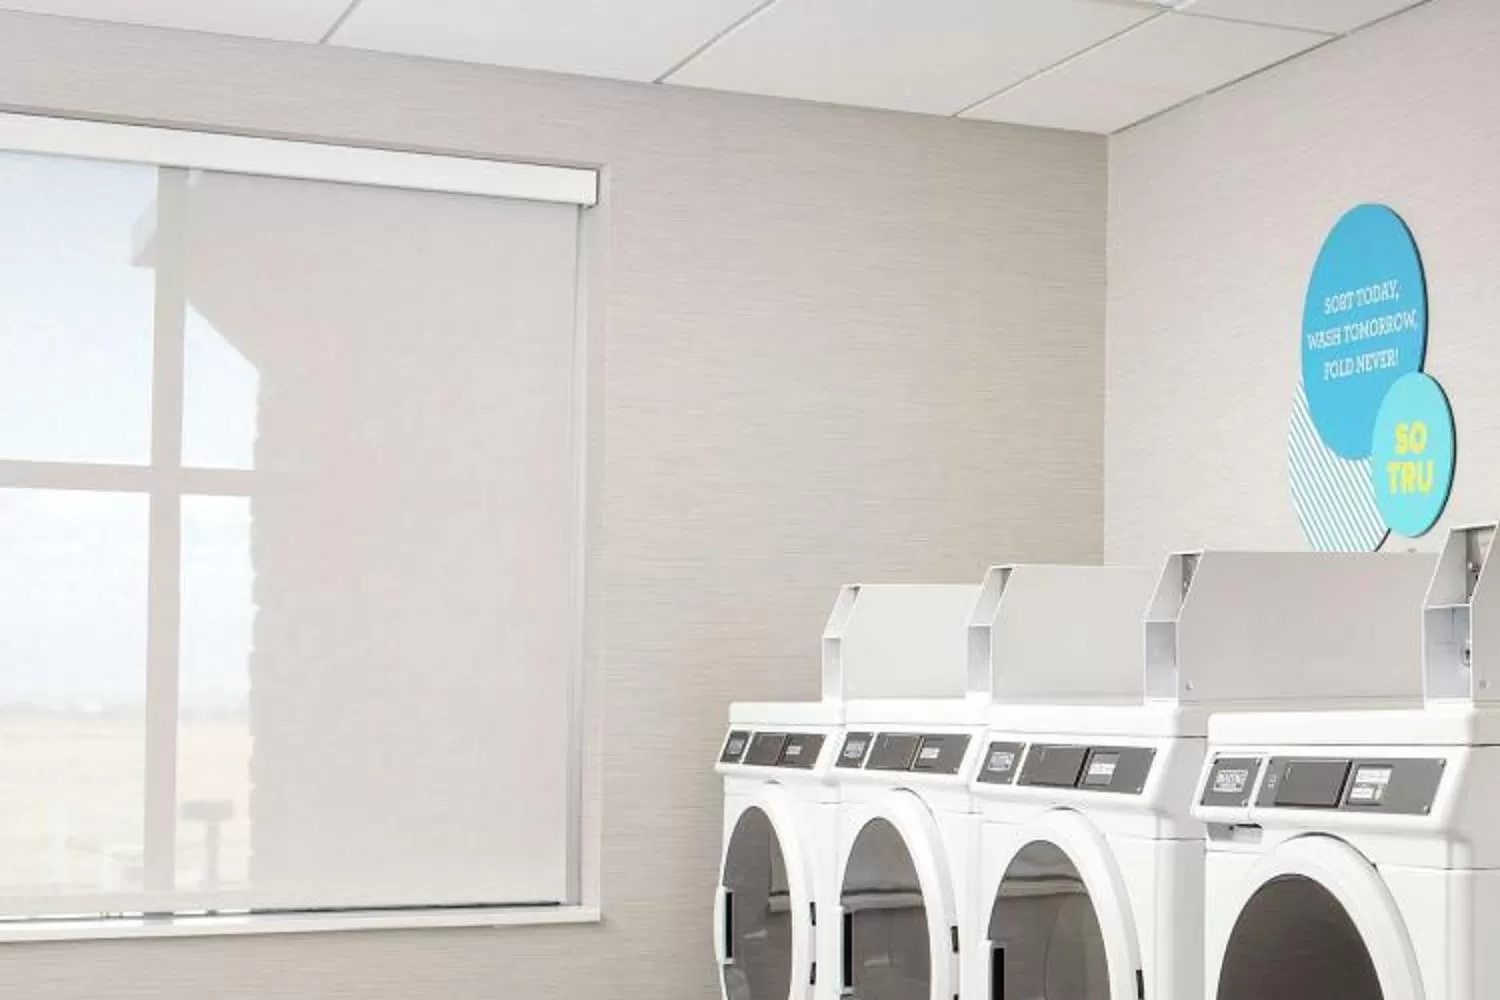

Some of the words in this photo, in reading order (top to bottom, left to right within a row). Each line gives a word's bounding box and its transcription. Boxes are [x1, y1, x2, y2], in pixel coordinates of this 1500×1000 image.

[1324, 291, 1354, 315] SORT
[1356, 279, 1400, 307] TODAY,
[1307, 328, 1341, 351] WASH
[1324, 358, 1354, 381] FOLD
[1356, 347, 1399, 373] NEVER!
[1394, 420, 1427, 456] SO
[1385, 459, 1434, 496] TRU
